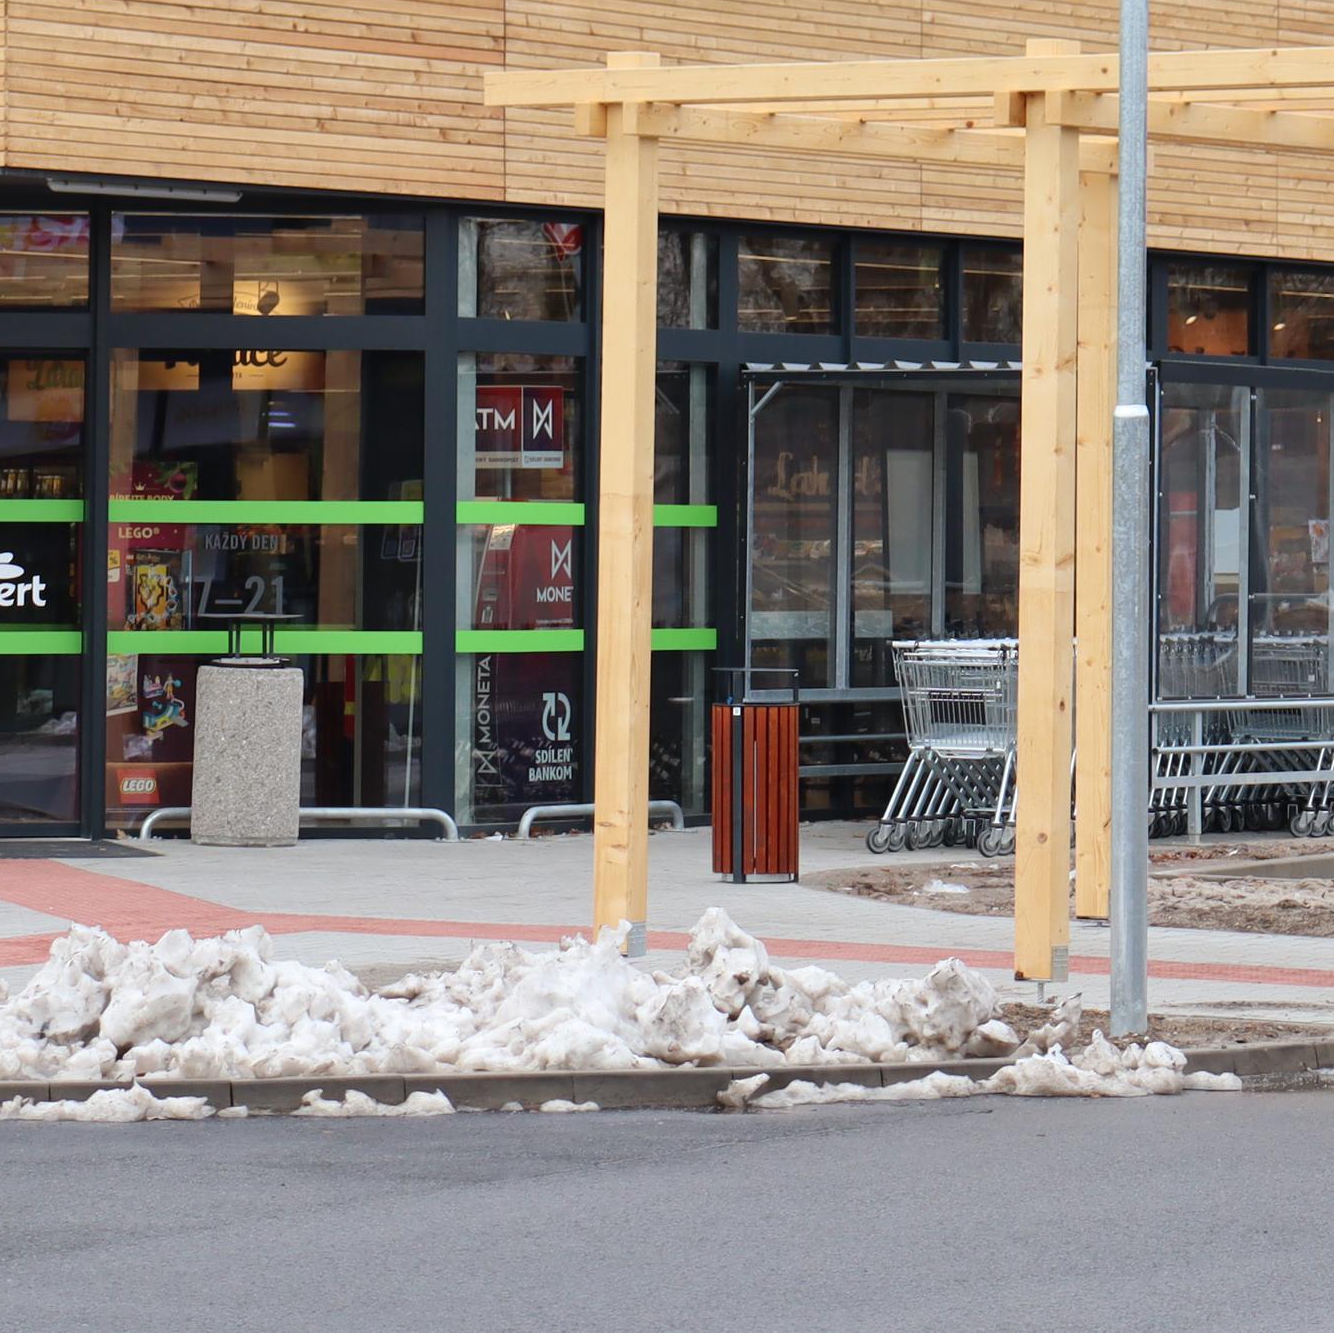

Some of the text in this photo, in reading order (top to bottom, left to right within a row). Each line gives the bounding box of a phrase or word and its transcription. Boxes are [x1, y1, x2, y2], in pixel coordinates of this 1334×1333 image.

[204, 531, 279, 551] KAŽDÝ DEN
[477, 655, 492, 743] MONETA
[122, 779, 155, 792] LEGO
